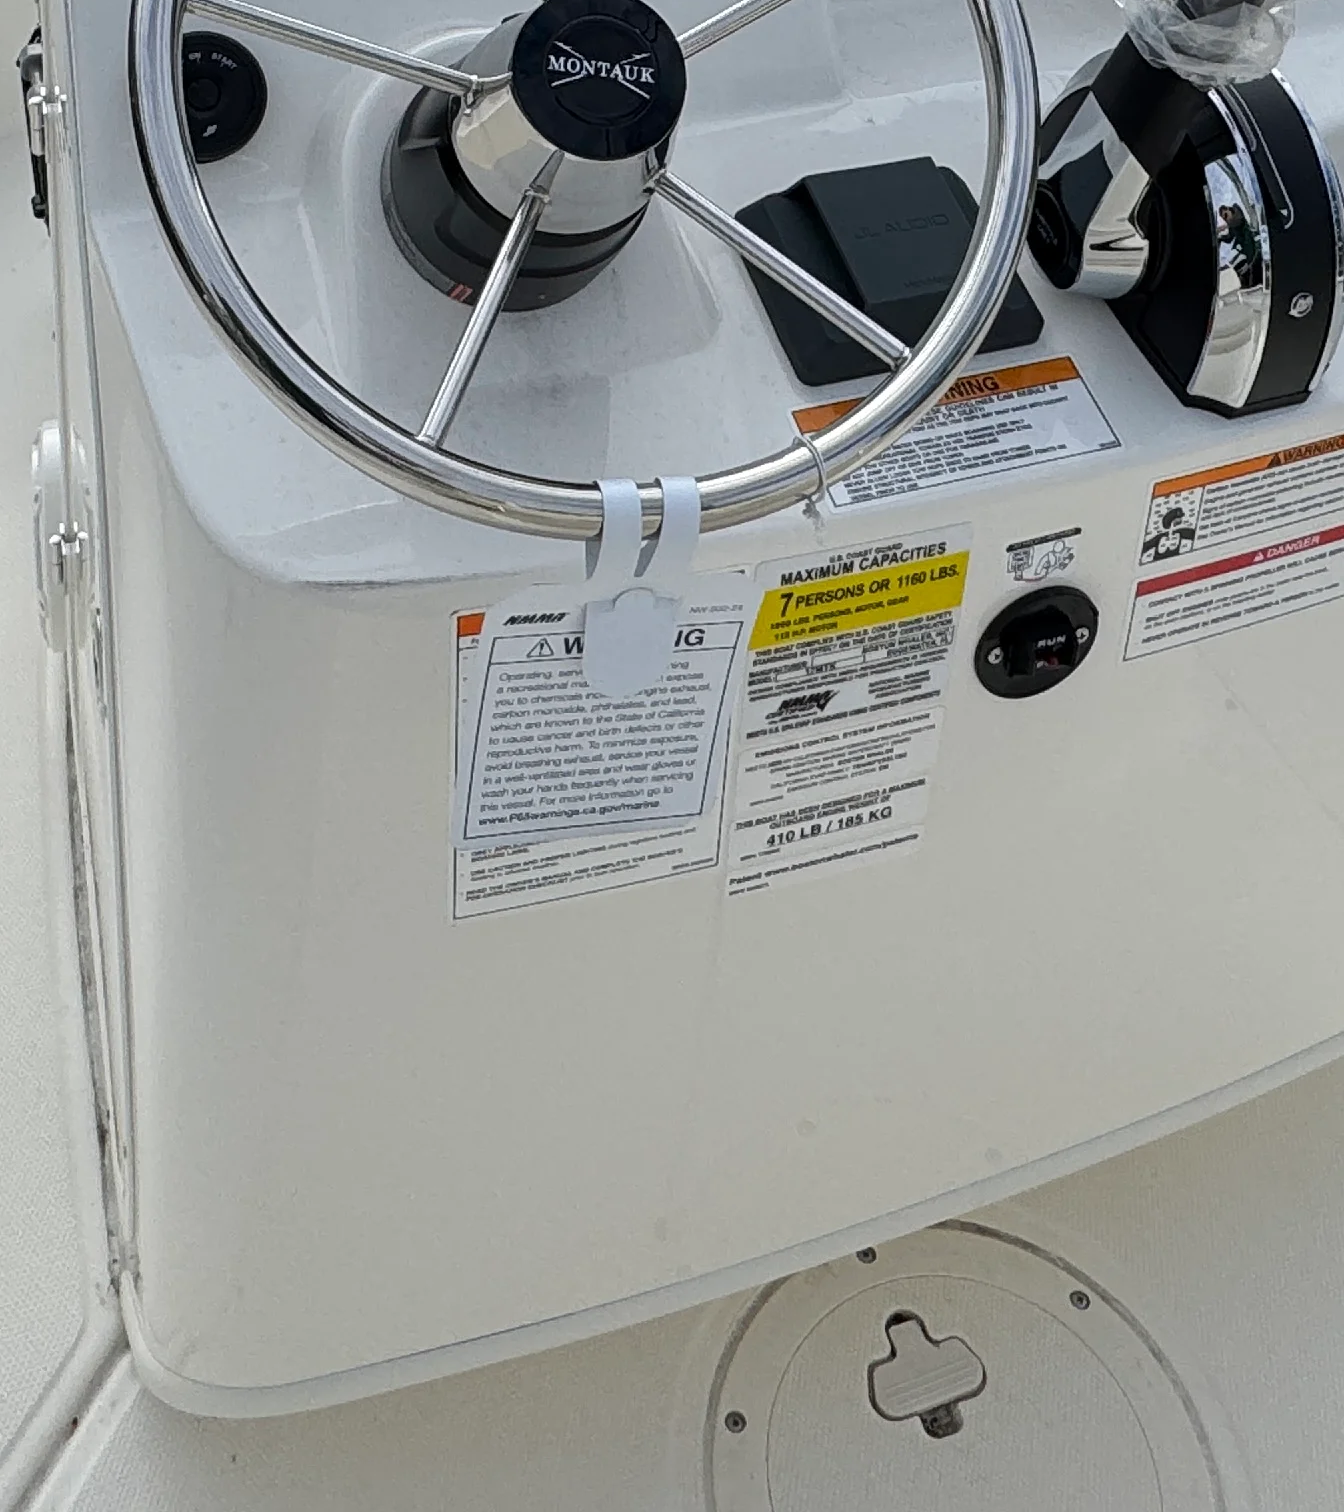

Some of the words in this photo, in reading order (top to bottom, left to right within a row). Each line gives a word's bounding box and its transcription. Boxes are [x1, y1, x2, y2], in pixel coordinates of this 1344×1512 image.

[547, 54, 656, 84] MONTAUK
[884, 213, 950, 232] AUDIO
[942, 375, 1000, 401] NING
[1266, 534, 1321, 559] DANGER
[780, 559, 855, 587] MAXIMUM
[858, 541, 948, 571] CAPACITIES
[780, 591, 794, 618] 7
[794, 581, 866, 611] PERSONS
[868, 578, 891, 594] OR
[896, 570, 927, 590] 1160
[929, 562, 960, 583] LBS.
[516, 696, 528, 705] to
[582, 716, 594, 725] to
[596, 714, 614, 724] the
[488, 736, 500, 746] to
[766, 829, 796, 847] 410
[799, 822, 823, 840] LB
[826, 819, 834, 834] /
[837, 812, 864, 830] 185
[868, 805, 893, 822] KG
